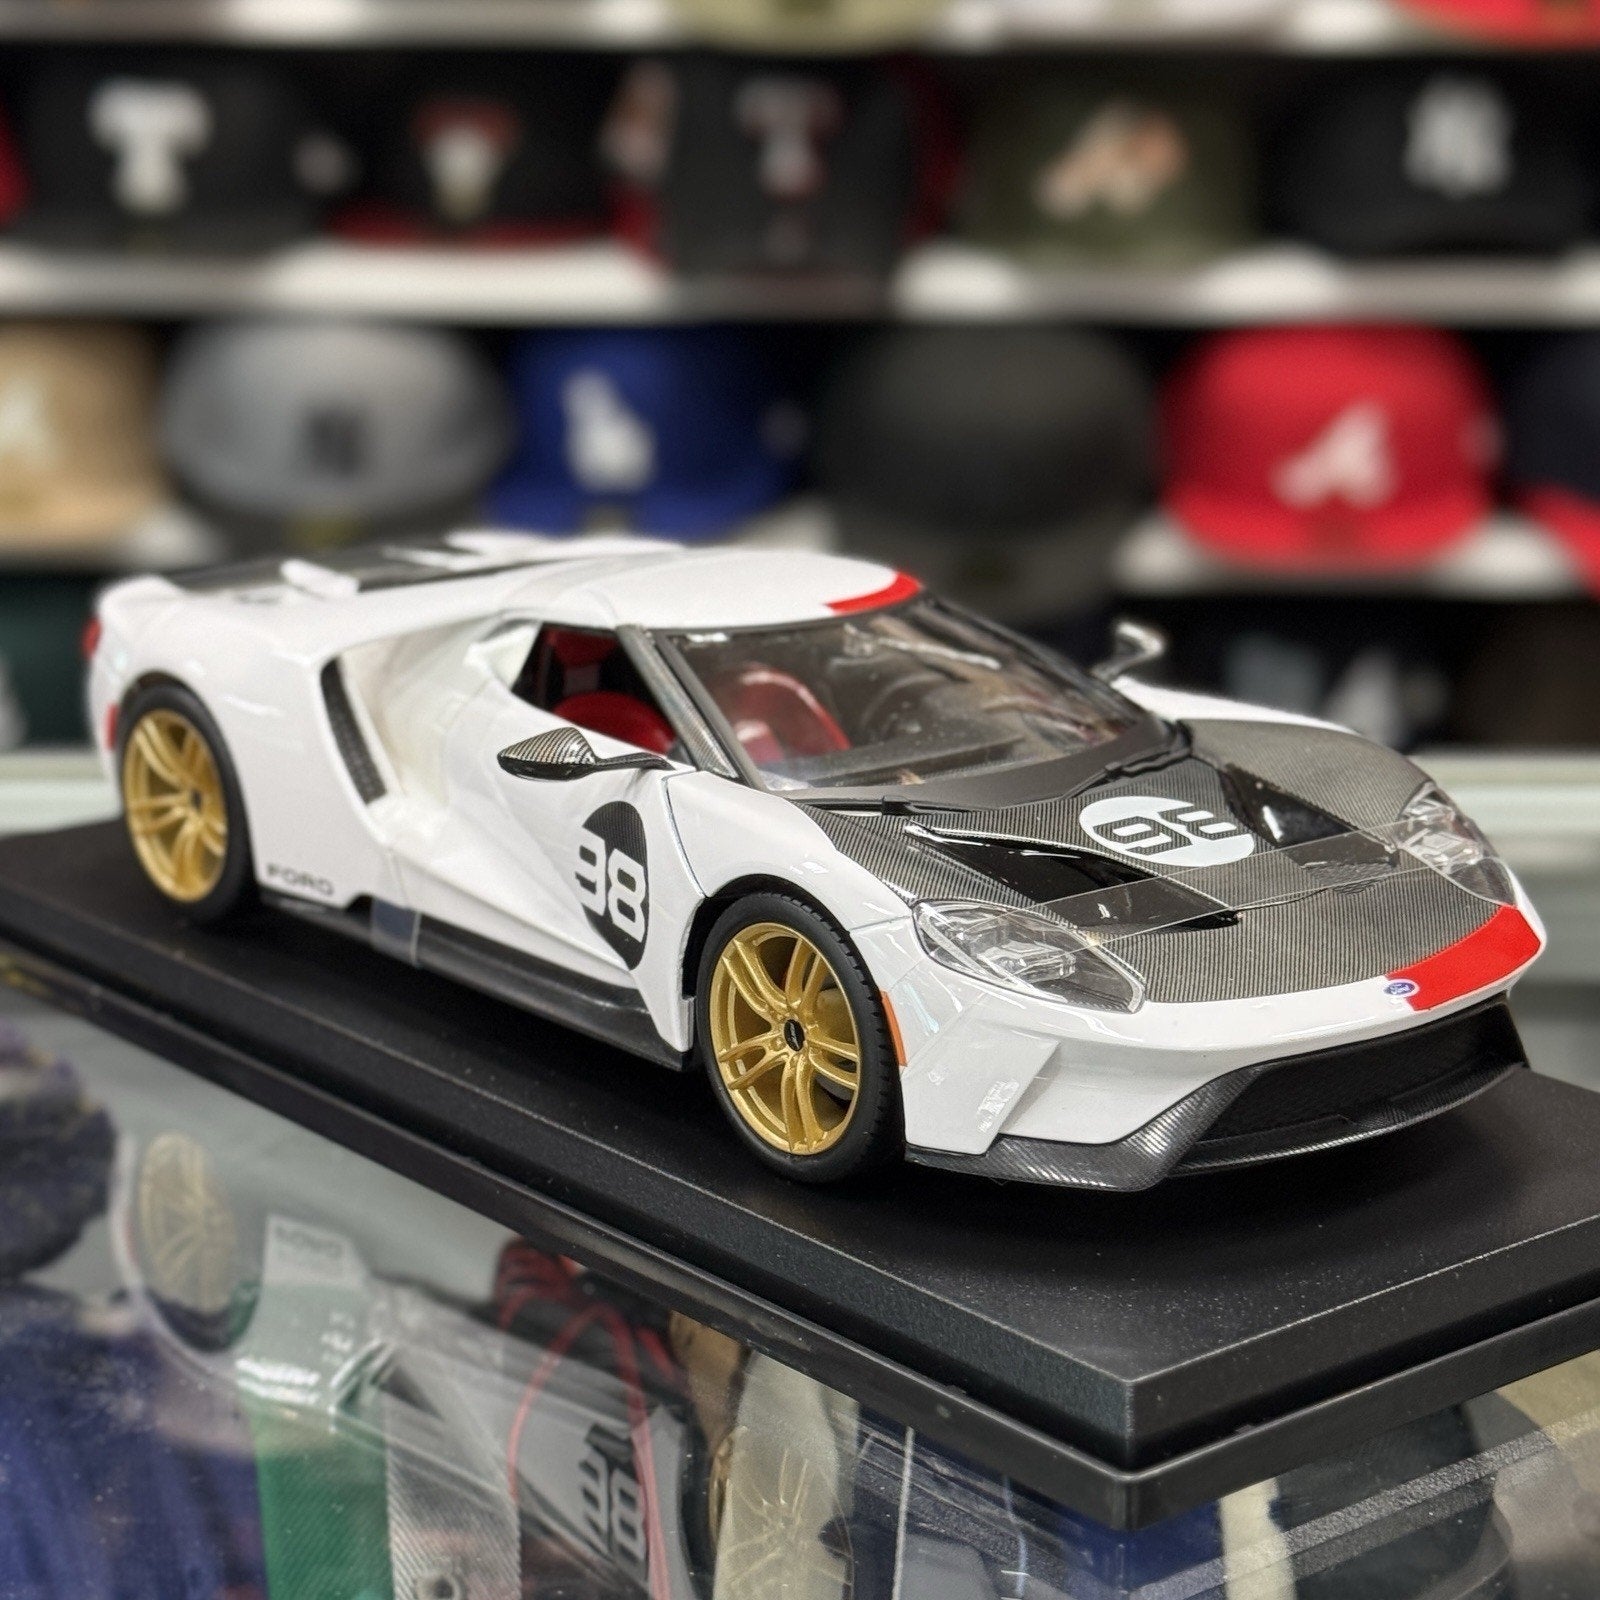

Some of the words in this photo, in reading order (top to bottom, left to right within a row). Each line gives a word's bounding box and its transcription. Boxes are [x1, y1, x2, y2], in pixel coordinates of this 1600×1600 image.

[1093, 806, 1240, 855] 98
[267, 863, 334, 895] FORD
[575, 827, 646, 943] 98
